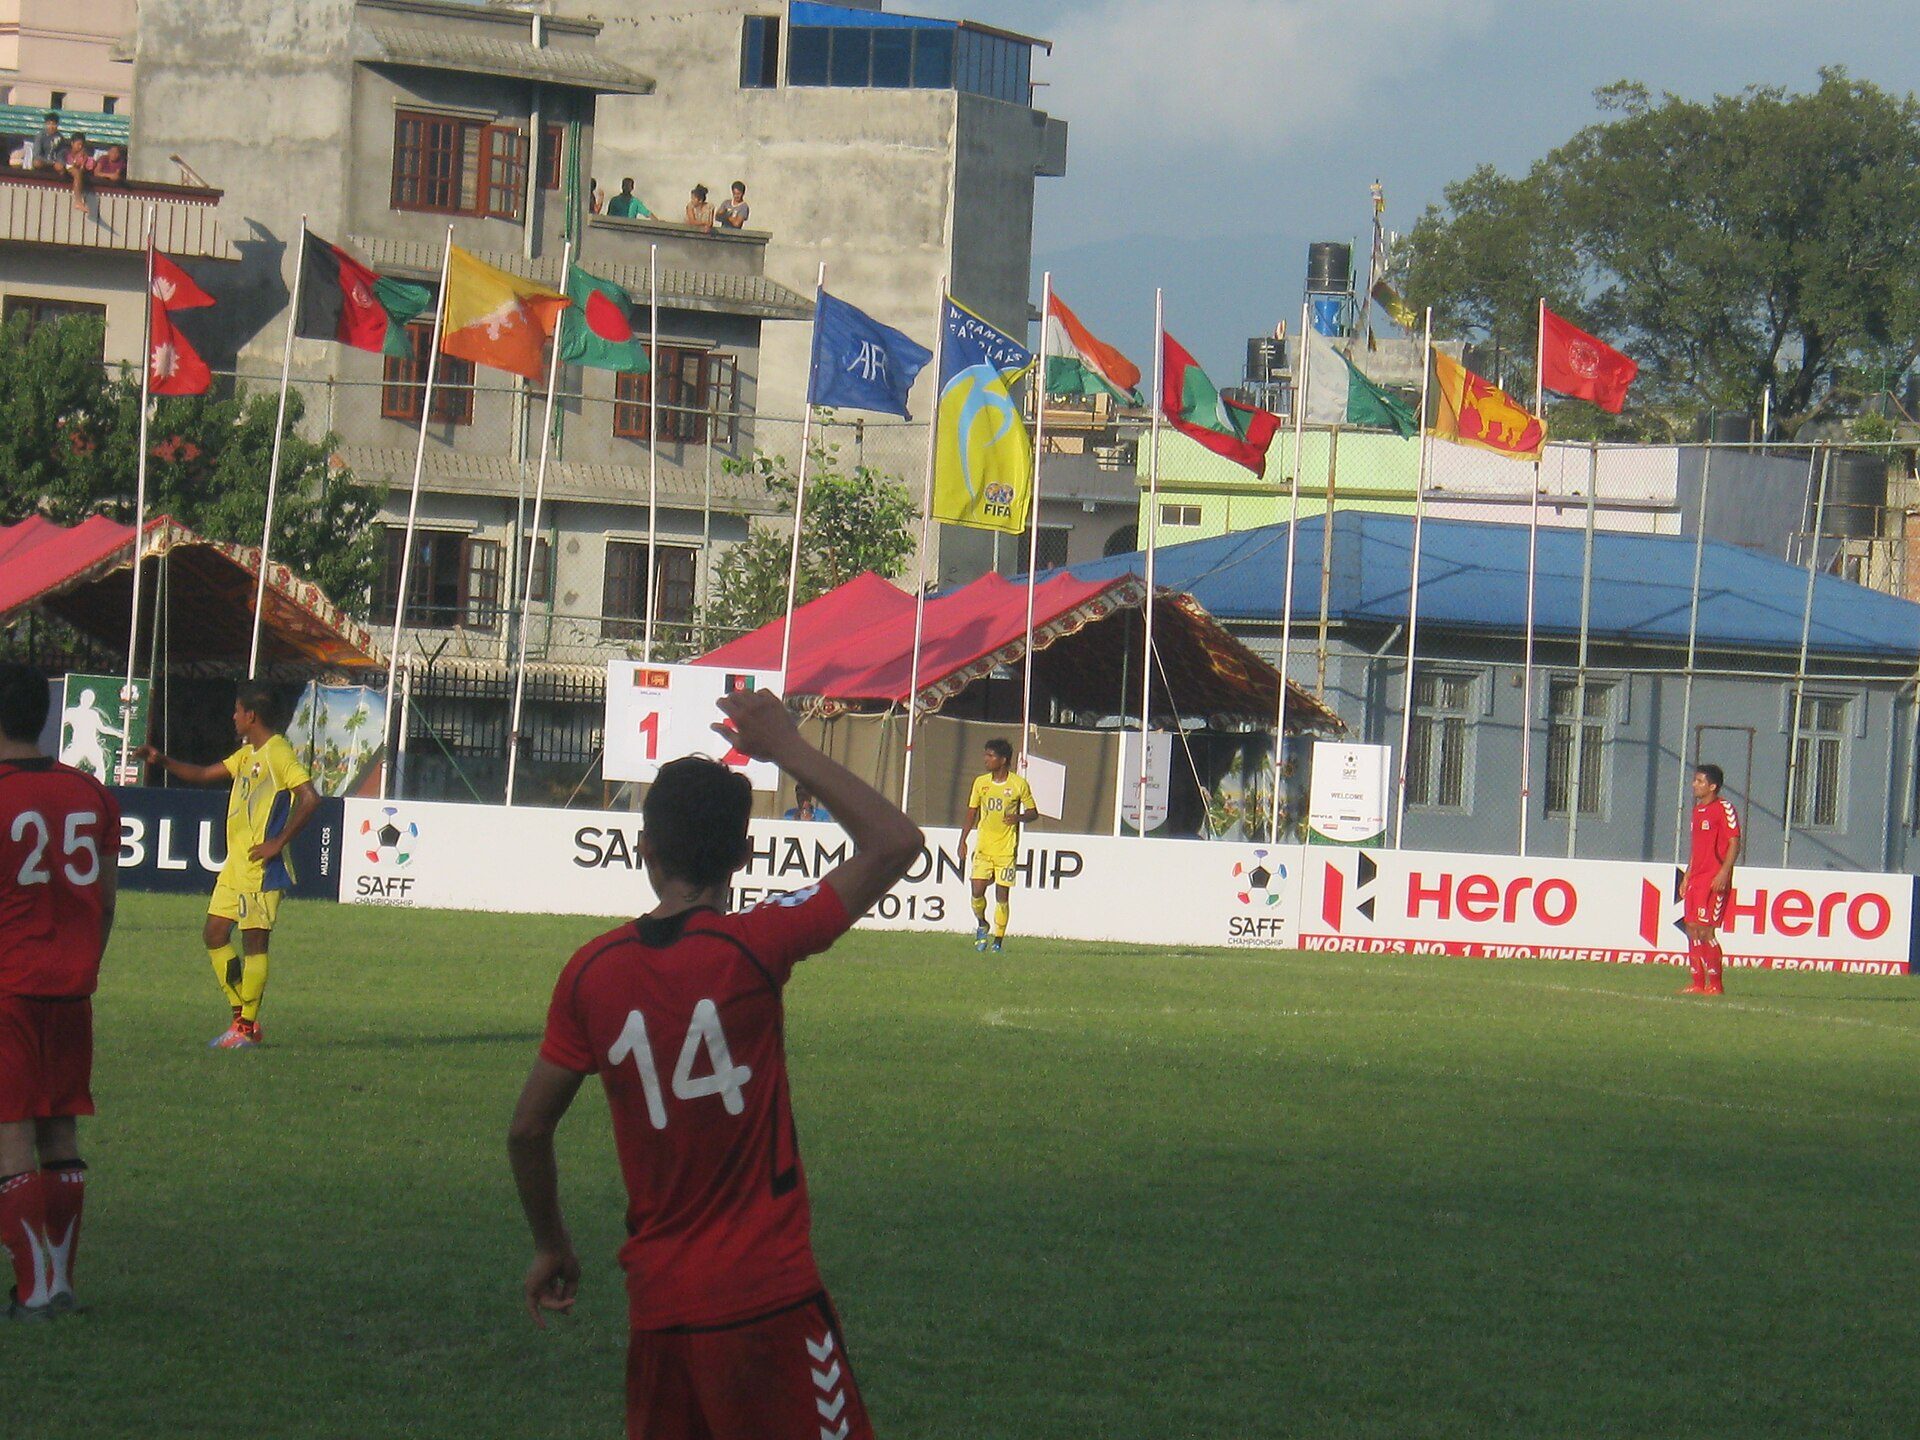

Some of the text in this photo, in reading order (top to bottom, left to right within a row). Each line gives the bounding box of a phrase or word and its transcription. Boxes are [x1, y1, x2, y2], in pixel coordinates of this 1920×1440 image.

[983, 503, 1012, 518] FIFA
[639, 712, 659, 760] 1
[988, 798, 1003, 811] 08
[1331, 793, 1364, 801] WELCOME
[11, 811, 101, 886] 25
[321, 846, 330, 876] MUSIC
[573, 827, 644, 870] SA
[356, 875, 416, 897] SAFF
[354, 897, 414, 906] CHAMPIONSHIP
[862, 893, 945, 922] 013
[1229, 916, 1285, 937] SAFF
[1227, 937, 1284, 947] CHAMPIONSHIP
[1304, 935, 1406, 954] WORLD'S
[1412, 941, 1451, 957] NO.
[1461, 944, 1472, 958] 1
[1841, 962, 1902, 976] INDIA
[607, 998, 752, 1130] 14
